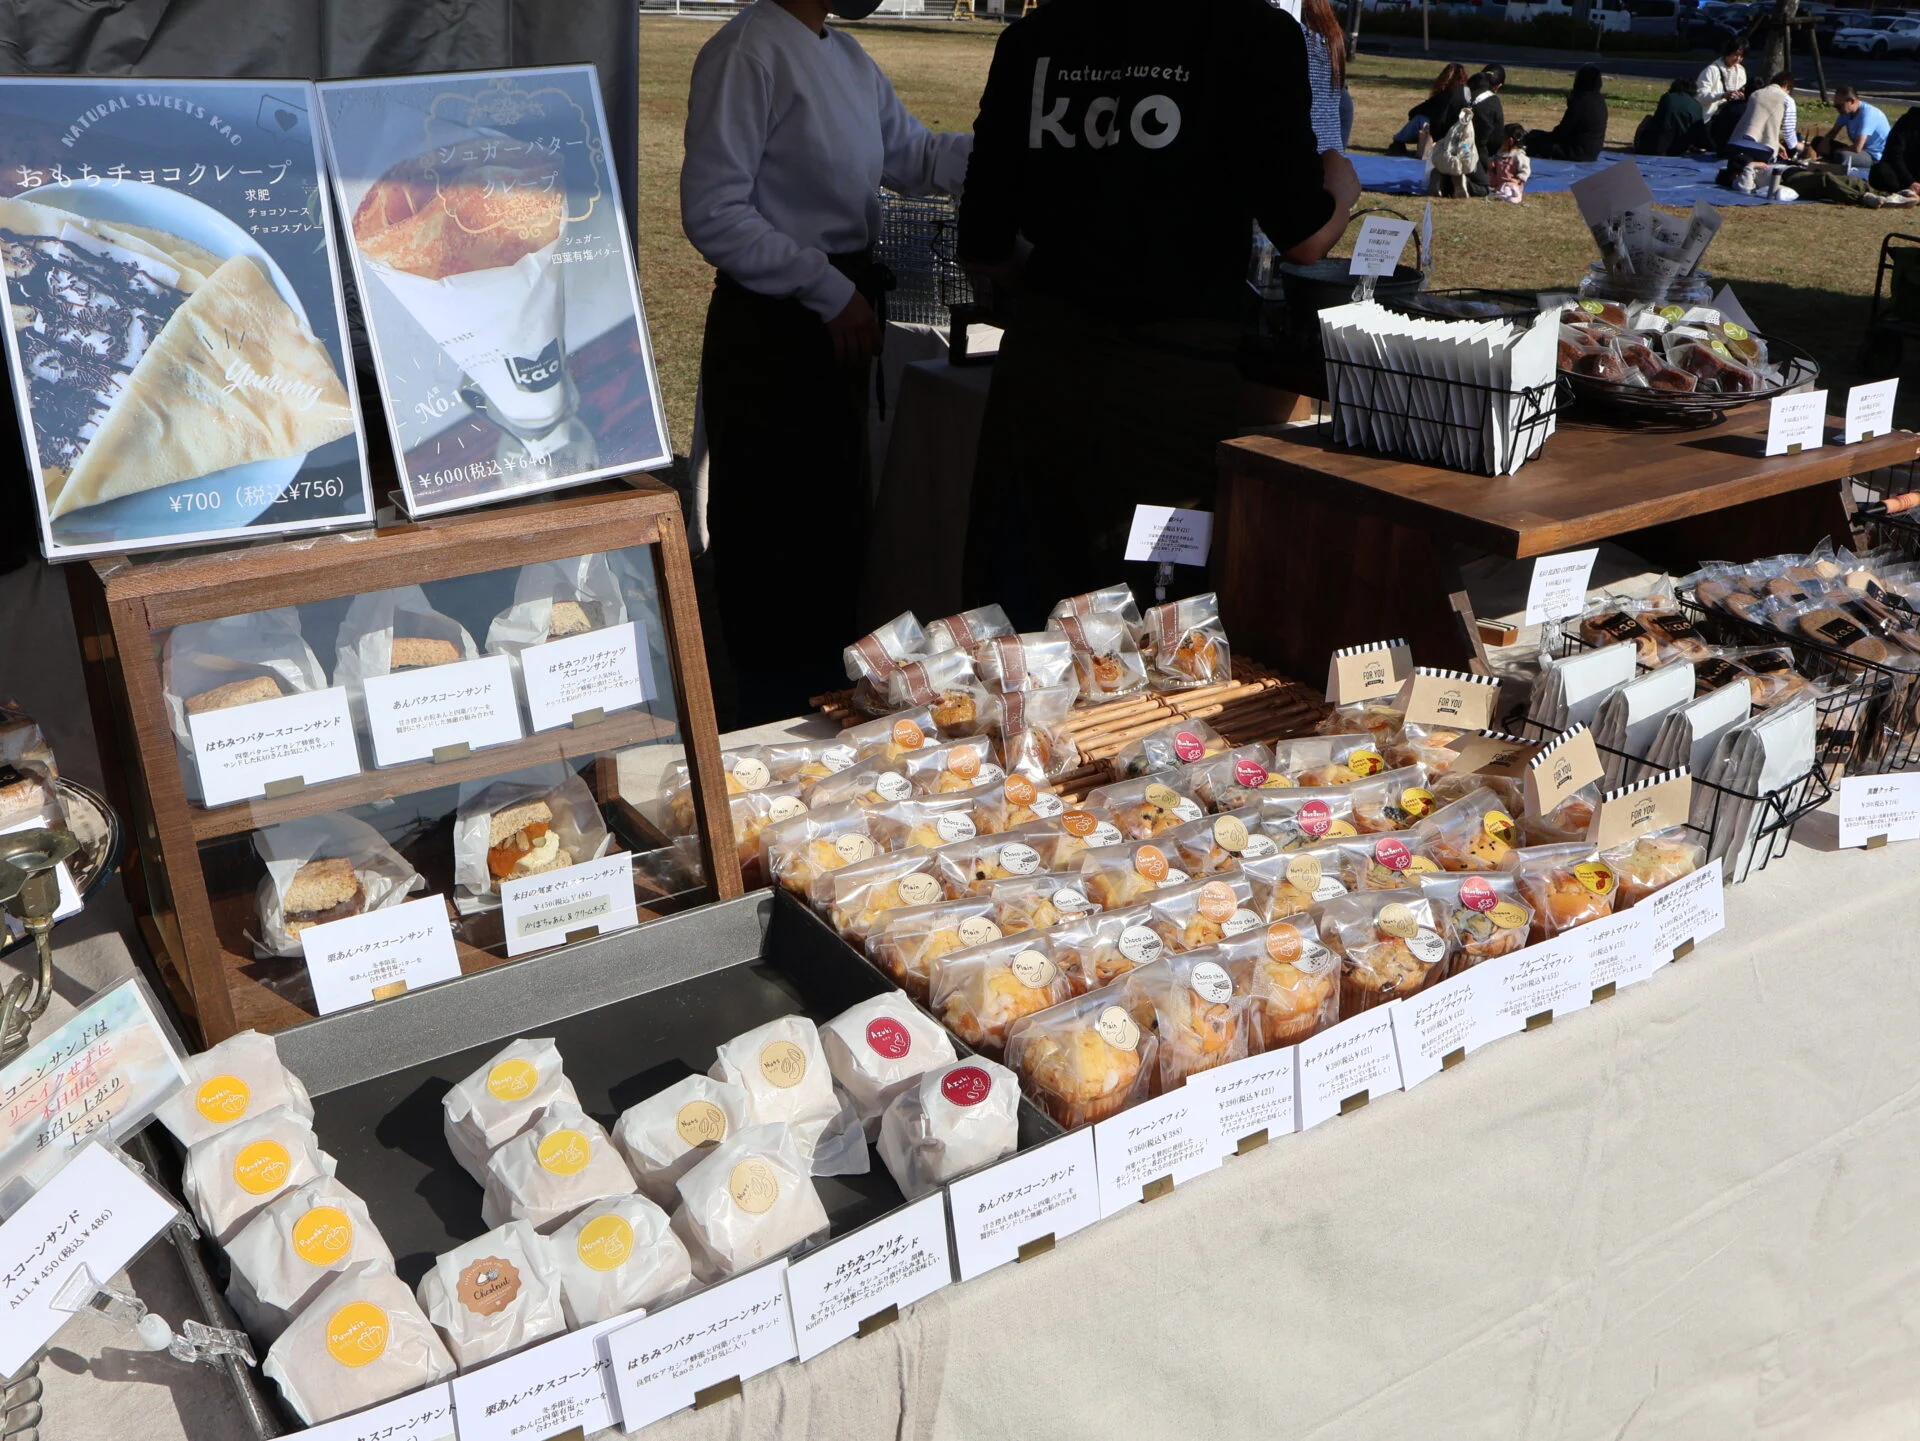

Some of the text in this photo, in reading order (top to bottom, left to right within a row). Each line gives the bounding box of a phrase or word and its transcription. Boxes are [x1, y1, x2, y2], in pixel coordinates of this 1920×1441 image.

[1125, 64, 1190, 82] sweets
[1029, 57, 1181, 149] kao
[61, 94, 242, 148] NATURAL SWEETS KAO
[437, 136, 584, 164] シュガーバター
[16, 159, 292, 188] おもちチョコクレープ
[245, 189, 270, 201] 求肥
[482, 171, 559, 200] クレープ
[247, 206, 310, 218] チョコソース
[250, 222, 323, 235] チョコスプレー
[564, 234, 601, 246] シュガー
[510, 357, 559, 384] kao
[415, 389, 463, 424] No.1
[169, 490, 221, 513] ¥700
[549, 647, 627, 673] はちみつクリチナッツ
[562, 657, 616, 679] スコーンサンド
[1363, 669, 1385, 681] FOR YOU
[392, 683, 491, 710] あんバタスコーンサンド
[1438, 697, 1463, 709] FOR YOU
[205, 716, 341, 752] はちみつバタースコーンサンド
[1553, 764, 1572, 782] FOR YOU
[943, 817, 971, 829] Choco chip
[1630, 804, 1656, 820] FOR YOU
[1138, 855, 1157, 863] Caramel
[1204, 891, 1226, 899] Caramel
[524, 915, 565, 931] かぼちゃあん
[1243, 917, 1256, 925] chip
[327, 926, 434, 963] 栗あんバタスコーンサンド
[1123, 936, 1141, 944] Choco
[1015, 963, 1033, 972] Plain
[1502, 955, 1574, 985] クリームチーズマフィン
[1519, 952, 1558, 971] ブルーベリー
[1195, 972, 1224, 980] Choco chip
[871, 1027, 892, 1039] Azuki
[1102, 1020, 1117, 1030] Plain
[0, 1019, 108, 1108] コーンサンドは
[764, 1059, 780, 1069] Nuts
[10, 1040, 113, 1120] リベイクせずに
[946, 1075, 970, 1089] Azuki
[201, 1089, 231, 1104] Pumpkin
[37, 1077, 120, 1147] お召し上がり
[681, 1118, 698, 1128] Nuts
[1128, 1107, 1189, 1139] プレーンマフィン
[239, 1155, 270, 1174] Pumpkin
[737, 1184, 750, 1201] Nuts
[977, 1164, 1075, 1213] あんバタスコーンサンド
[299, 1223, 329, 1248] Pumpkin
[582, 1236, 605, 1252] Honey
[2, 1209, 80, 1288] スコーンサンド
[836, 1234, 904, 1276] はちみつクリチ
[823, 1237, 919, 1293] ナッツスコーンサンド
[9, 1285, 34, 1309] ALL
[473, 1276, 509, 1300] Chestnut
[332, 1319, 366, 1344] Pumpkin
[627, 1294, 783, 1371] はちみつバタースコーンサンド
[672, 1341, 748, 1379] Kaoさんのお気に入り
[510, 1393, 608, 1436] 栗あんに四葉有塩バターを
[542, 1396, 574, 1413] 冬季限定
[535, 1409, 584, 1433] 合わせました
